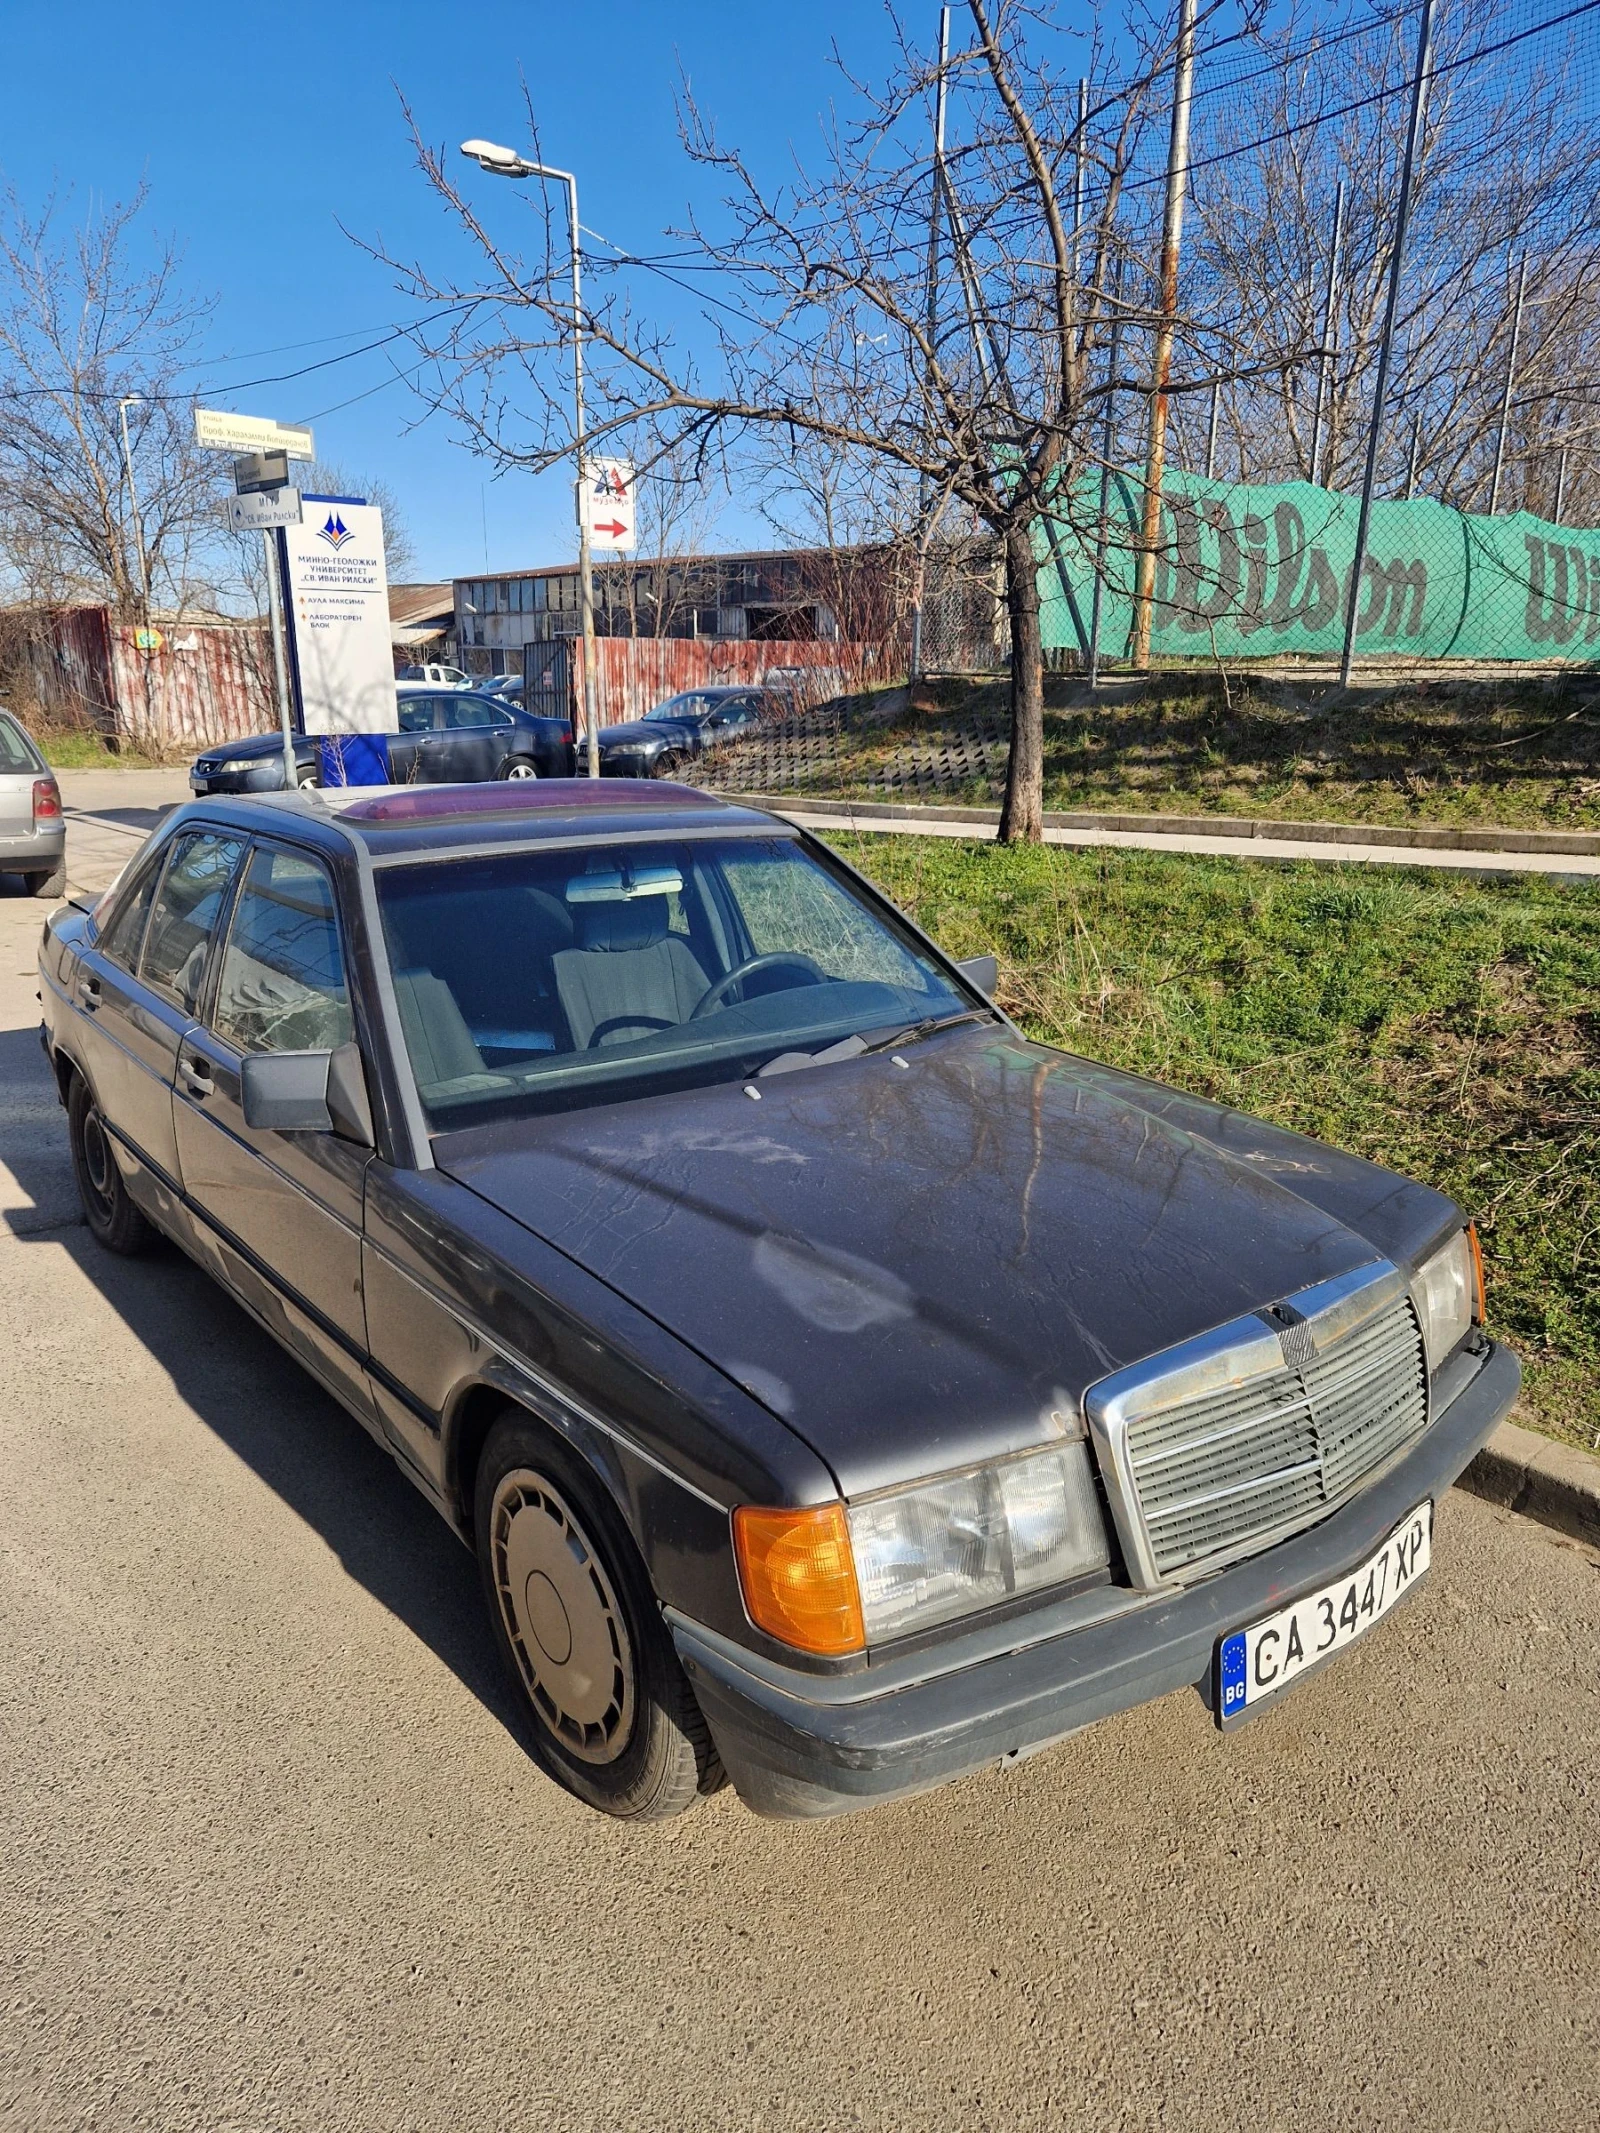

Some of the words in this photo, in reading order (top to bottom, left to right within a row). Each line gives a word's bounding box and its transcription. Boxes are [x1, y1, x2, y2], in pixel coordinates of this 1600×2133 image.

[298, 556, 377, 566] МИННО-ГЕОЛОЖКИ
[1134, 490, 1428, 637] Wilson
[310, 566, 367, 575] УНИВЕРСИТЕТ
[318, 575, 340, 583] ИВАН
[309, 614, 362, 622] ЛАБОРАТОРЕН
[1254, 1615, 1304, 1687] CA
[1317, 1550, 1389, 1652] 3447
[1395, 1520, 1424, 1591] XP
[1226, 1681, 1245, 1705] BG
